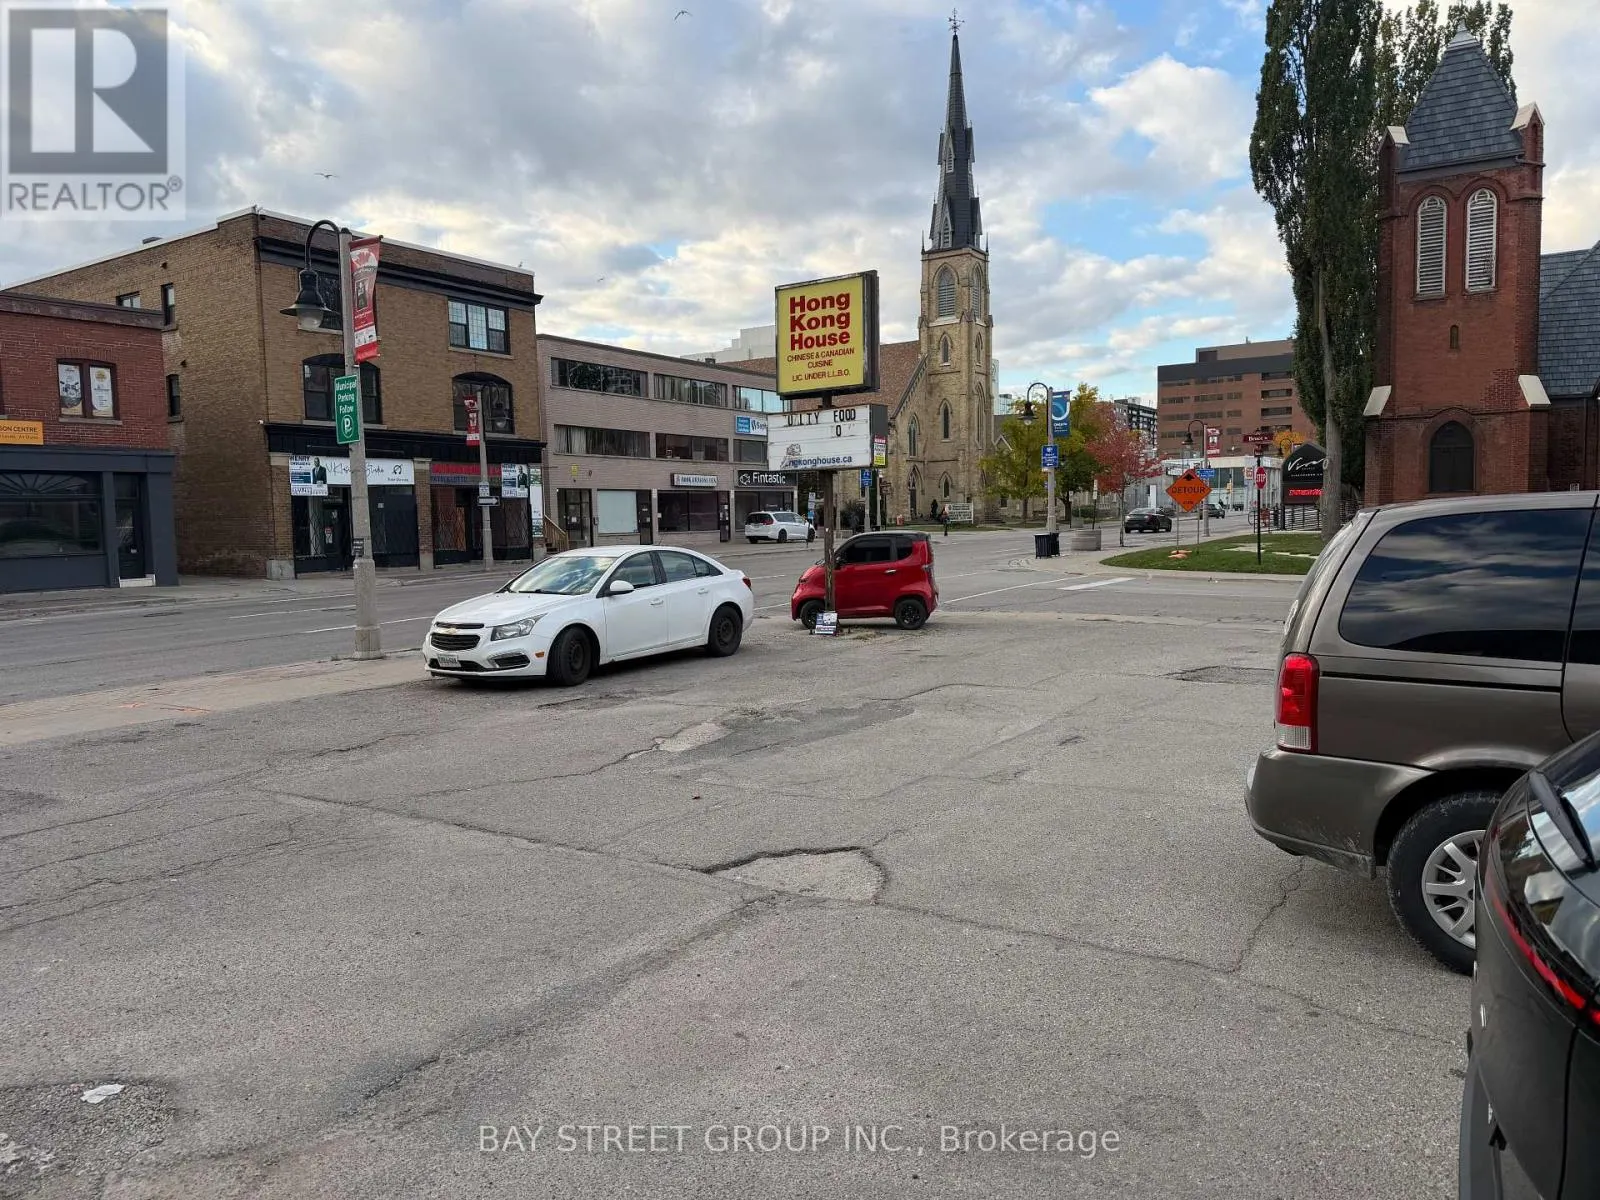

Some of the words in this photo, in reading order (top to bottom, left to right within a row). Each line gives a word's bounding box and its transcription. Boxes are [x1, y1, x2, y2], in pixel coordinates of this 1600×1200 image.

[789, 293, 851, 315] Hong
[790, 311, 851, 333] Kong
[790, 330, 851, 351] House
[787, 352, 814, 362] CHINESE
[815, 352, 819, 360] &
[820, 347, 855, 358] CANADIAN
[807, 359, 833, 369] CUISINE
[804, 371, 827, 380] UNDER
[335, 380, 357, 391] Municipal
[337, 393, 355, 403] Parking
[339, 405, 354, 414] Follow
[833, 409, 856, 423] FOOD
[752, 472, 786, 484] Fintastic
[1256, 473, 1266, 483] STOP
[1171, 486, 1206, 494] DETOUR
